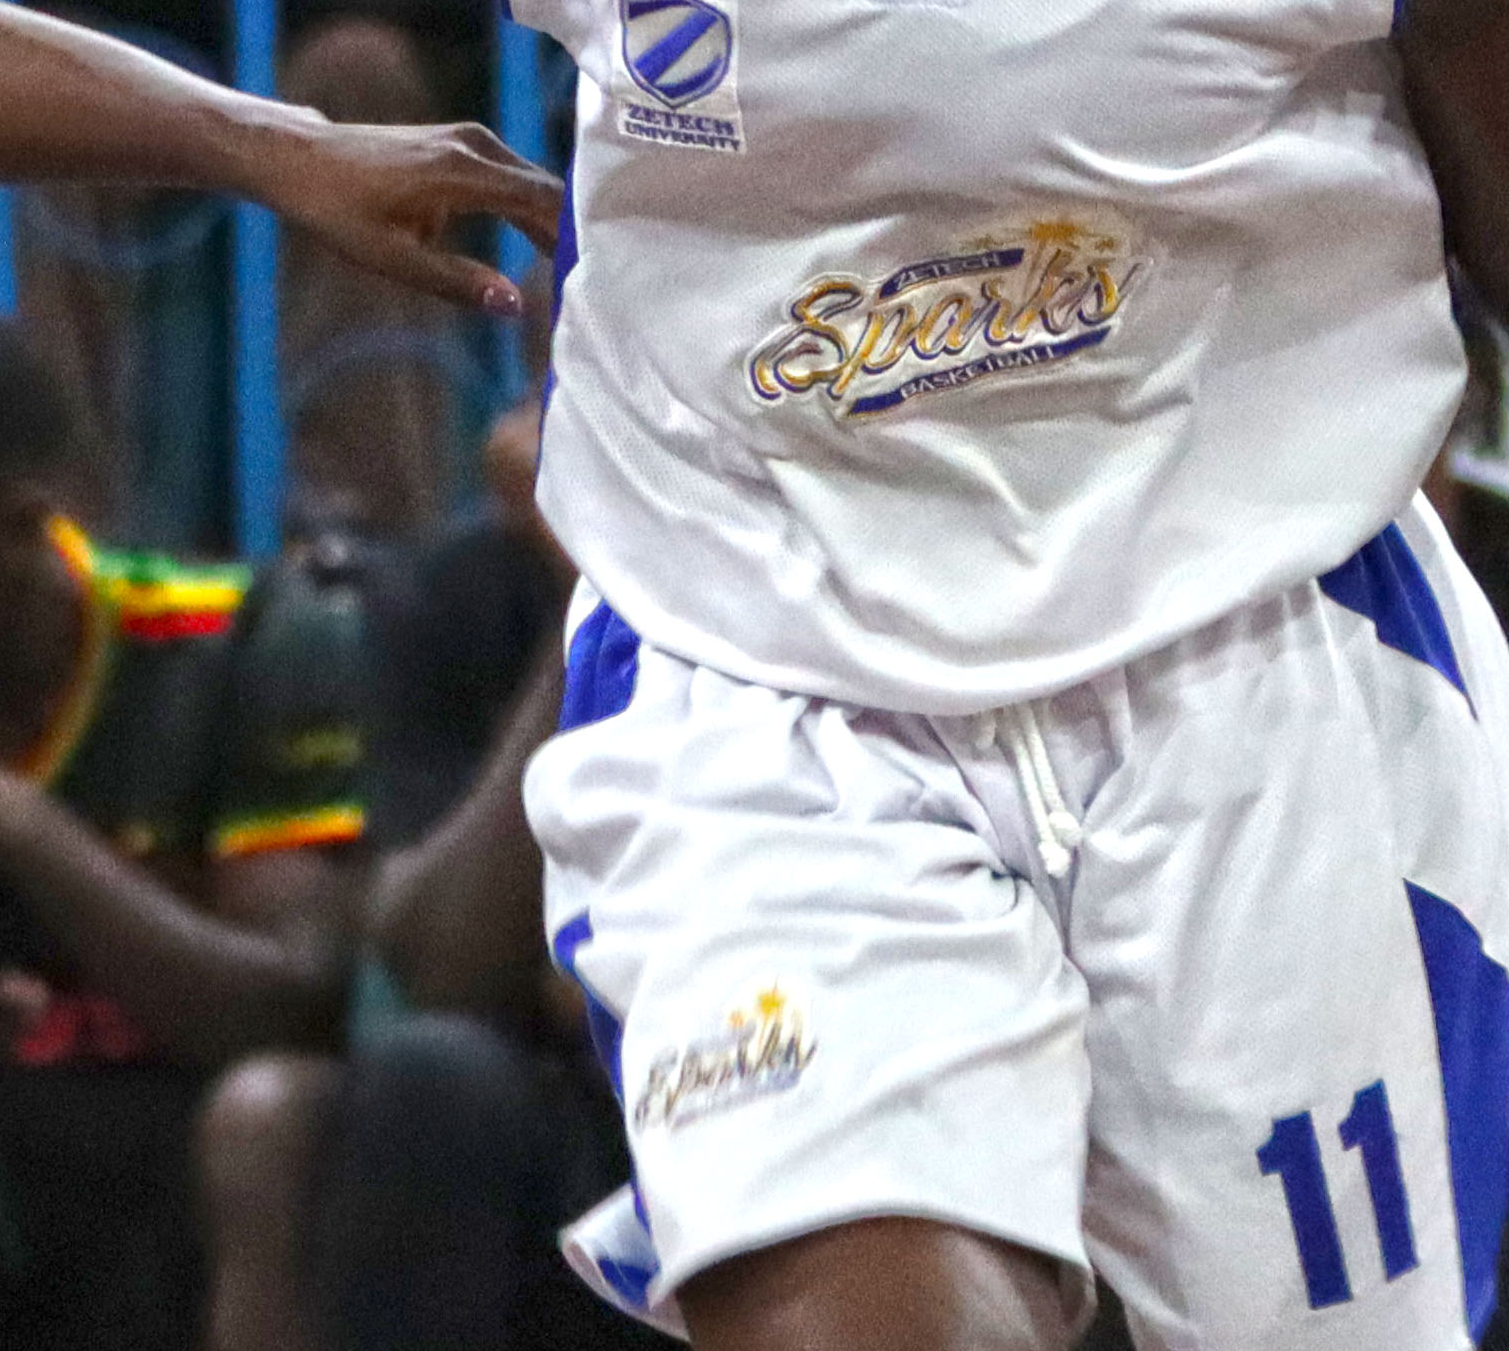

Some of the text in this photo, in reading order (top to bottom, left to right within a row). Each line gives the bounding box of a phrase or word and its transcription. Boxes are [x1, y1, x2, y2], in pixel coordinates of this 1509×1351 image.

[624, 119, 741, 152] UNIVERSITY
[625, 103, 736, 137] ZETECH
[750, 246, 1150, 401] Sparks
[1255, 1078, 1421, 1311] 11
